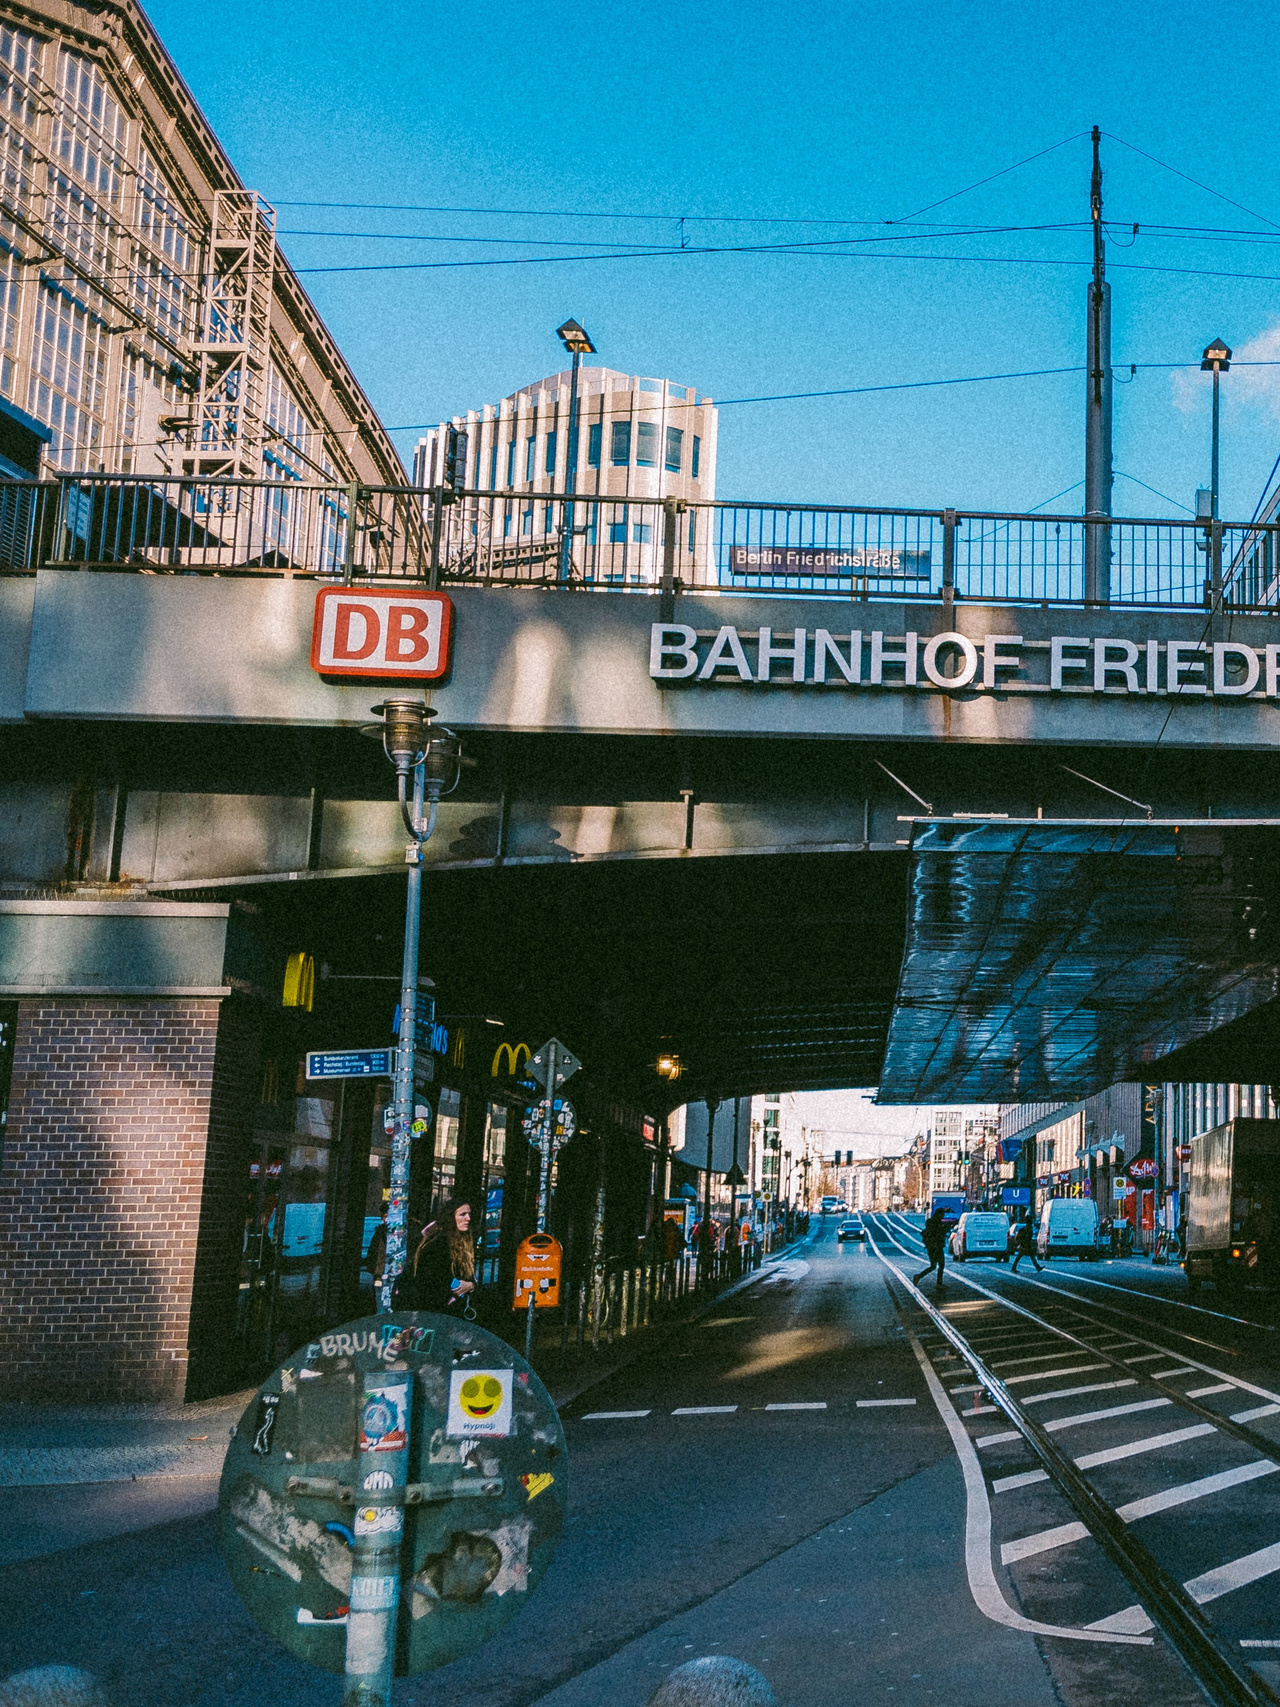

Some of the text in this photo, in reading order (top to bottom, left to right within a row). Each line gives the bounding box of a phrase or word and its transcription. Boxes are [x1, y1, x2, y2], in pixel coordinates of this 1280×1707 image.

[736, 550, 901, 569] Berlin Friedrichstraße
[332, 603, 430, 663] DB
[649, 623, 1023, 690] BAHNHOF
[1013, 1189, 1020, 1198] U
[463, 1422, 496, 1431] Hypnoji
